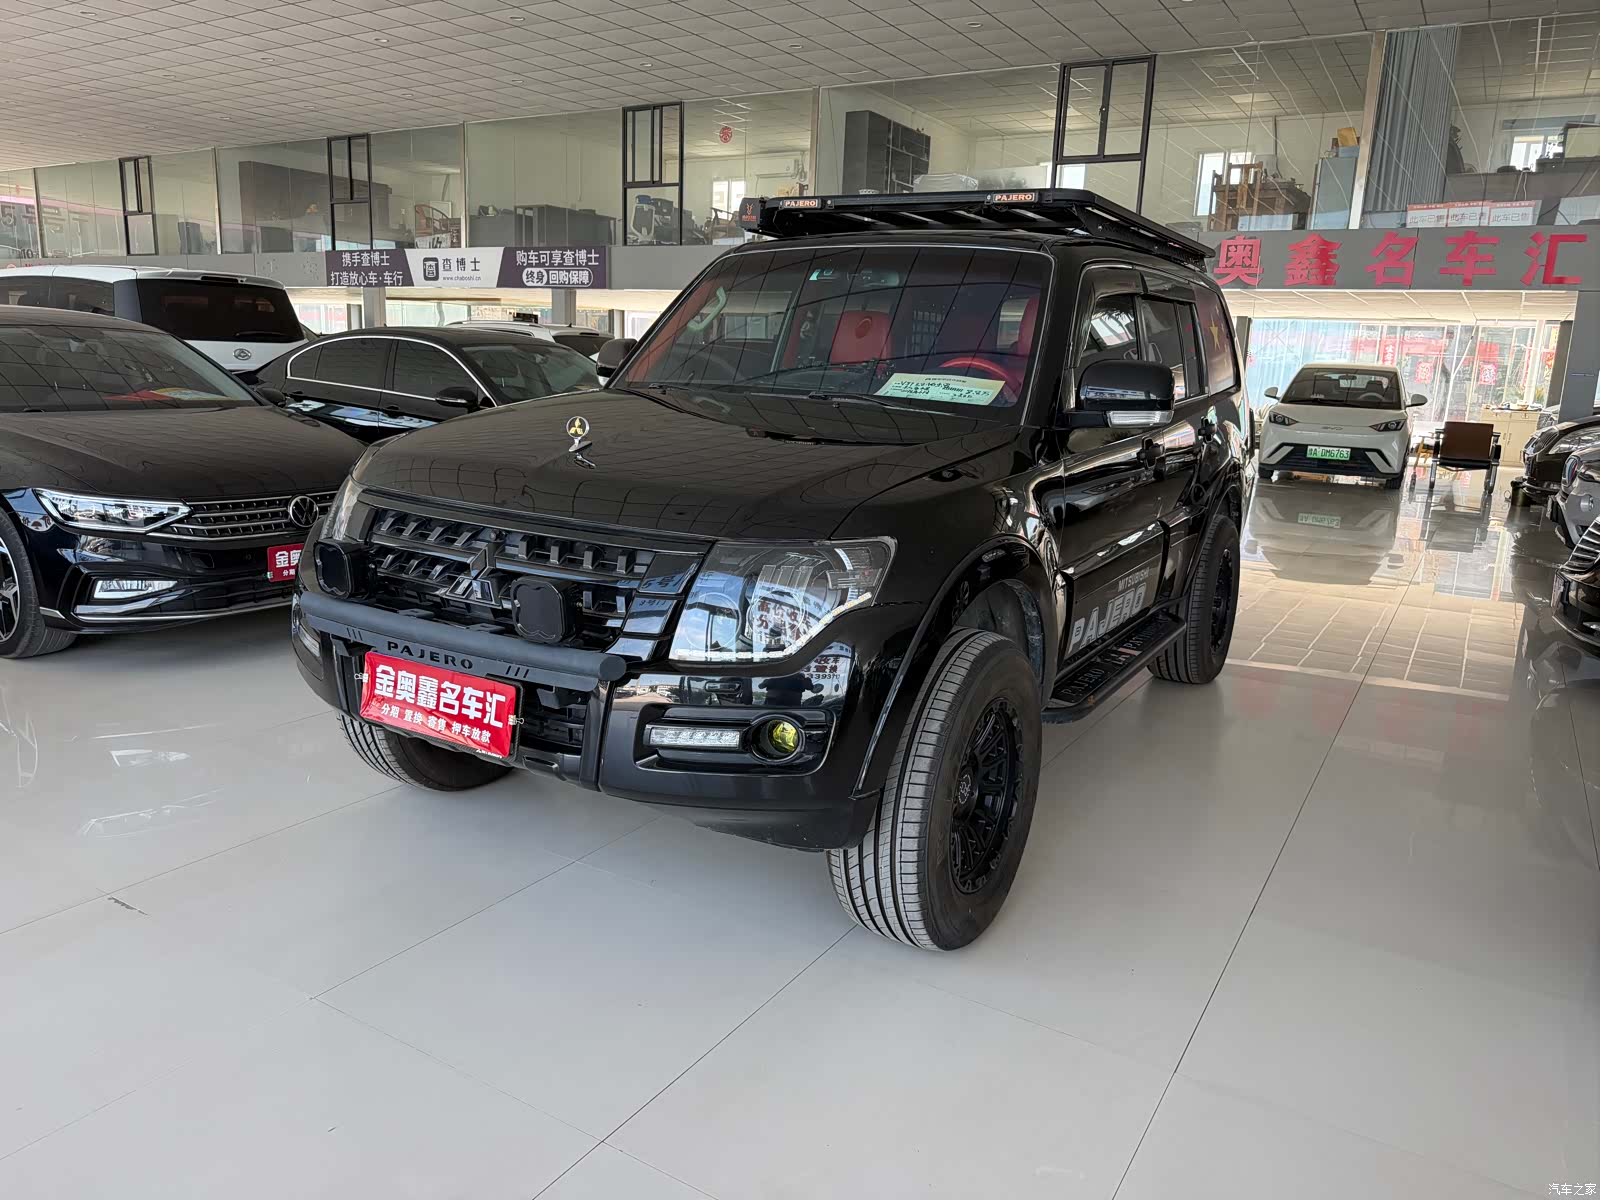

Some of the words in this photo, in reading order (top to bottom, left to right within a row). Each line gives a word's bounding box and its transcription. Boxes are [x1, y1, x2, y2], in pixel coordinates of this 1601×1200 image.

[342, 251, 390, 267] 携手查博士
[441, 257, 481, 272] 查博士
[516, 249, 600, 266] 购车可享查博士
[1213, 230, 1589, 287] 奥鑫名车汇
[331, 271, 404, 286] 打造放心车·车行
[525, 270, 546, 285] 终身
[549, 270, 590, 285] 回购保障
[1320, 448, 1350, 459] DM6763
[1117, 566, 1150, 592] MITSUBISHI
[1067, 582, 1147, 654] PAJERO
[387, 640, 474, 670] PAJERO
[374, 664, 506, 728] 金奥鑫名车汇
[381, 702, 401, 718] 分期
[403, 708, 424, 725] 置换
[451, 720, 492, 745] 押车放款
